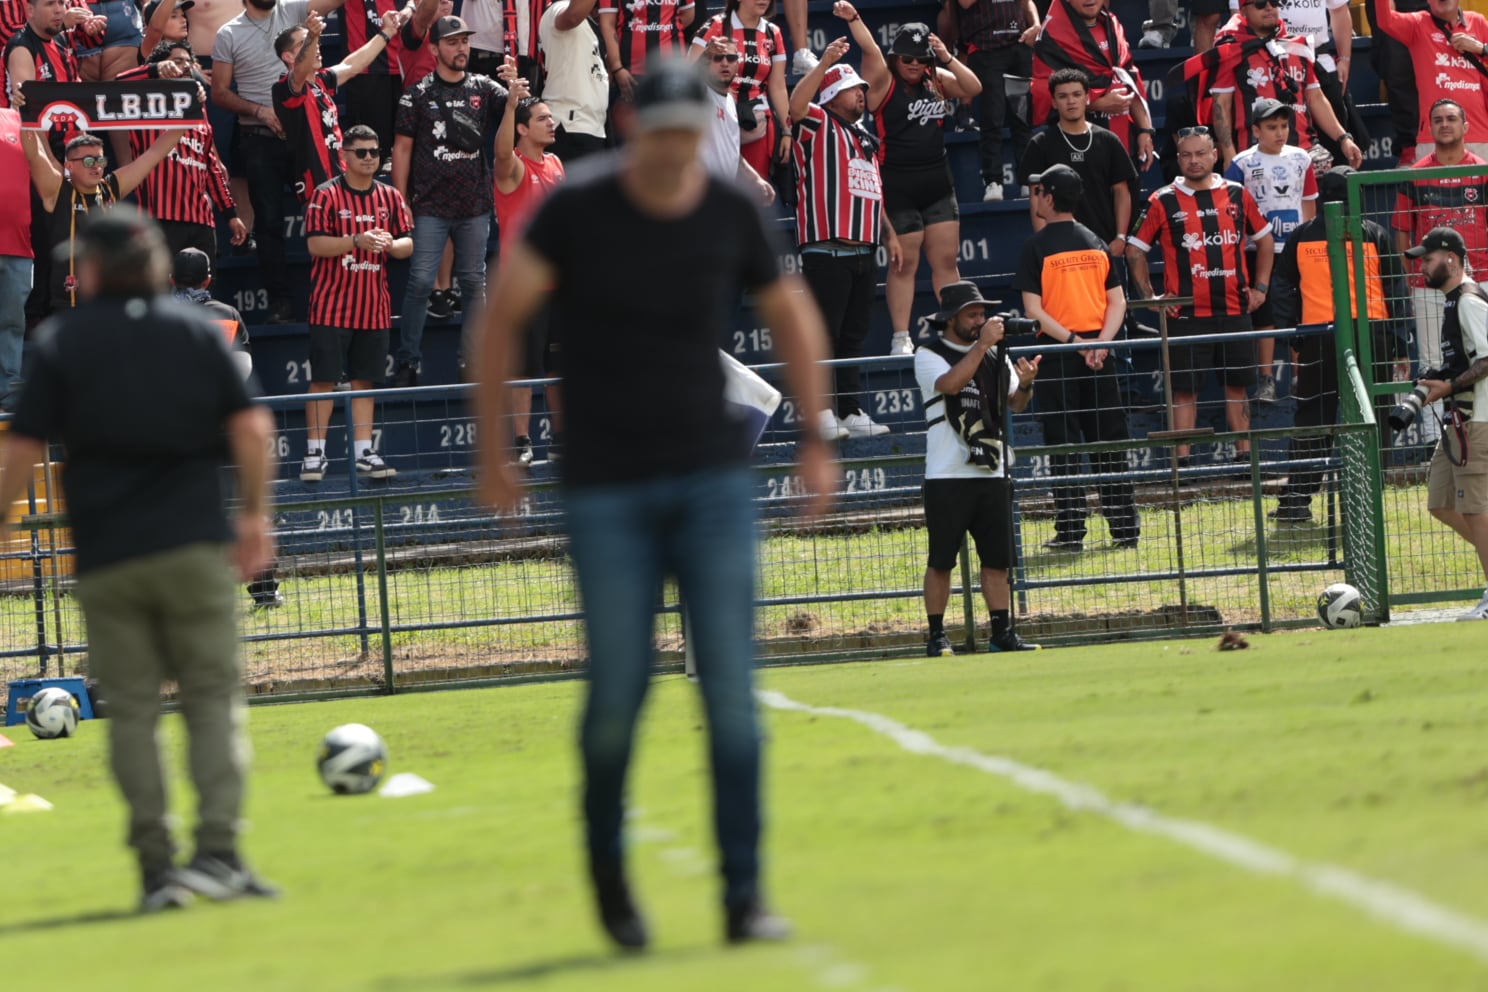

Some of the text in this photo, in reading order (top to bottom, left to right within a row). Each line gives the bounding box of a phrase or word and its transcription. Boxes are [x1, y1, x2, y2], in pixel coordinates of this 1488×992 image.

[96, 92, 191, 119] L.B.D.P
[908, 98, 946, 125] Liga
[1203, 232, 1240, 247] kölbi
[234, 289, 268, 310] 193
[733, 329, 772, 352] 215
[876, 390, 913, 414] 233
[441, 424, 477, 447] 228
[846, 469, 884, 492] 249
[317, 509, 353, 530] 243
[400, 504, 438, 524] 244
